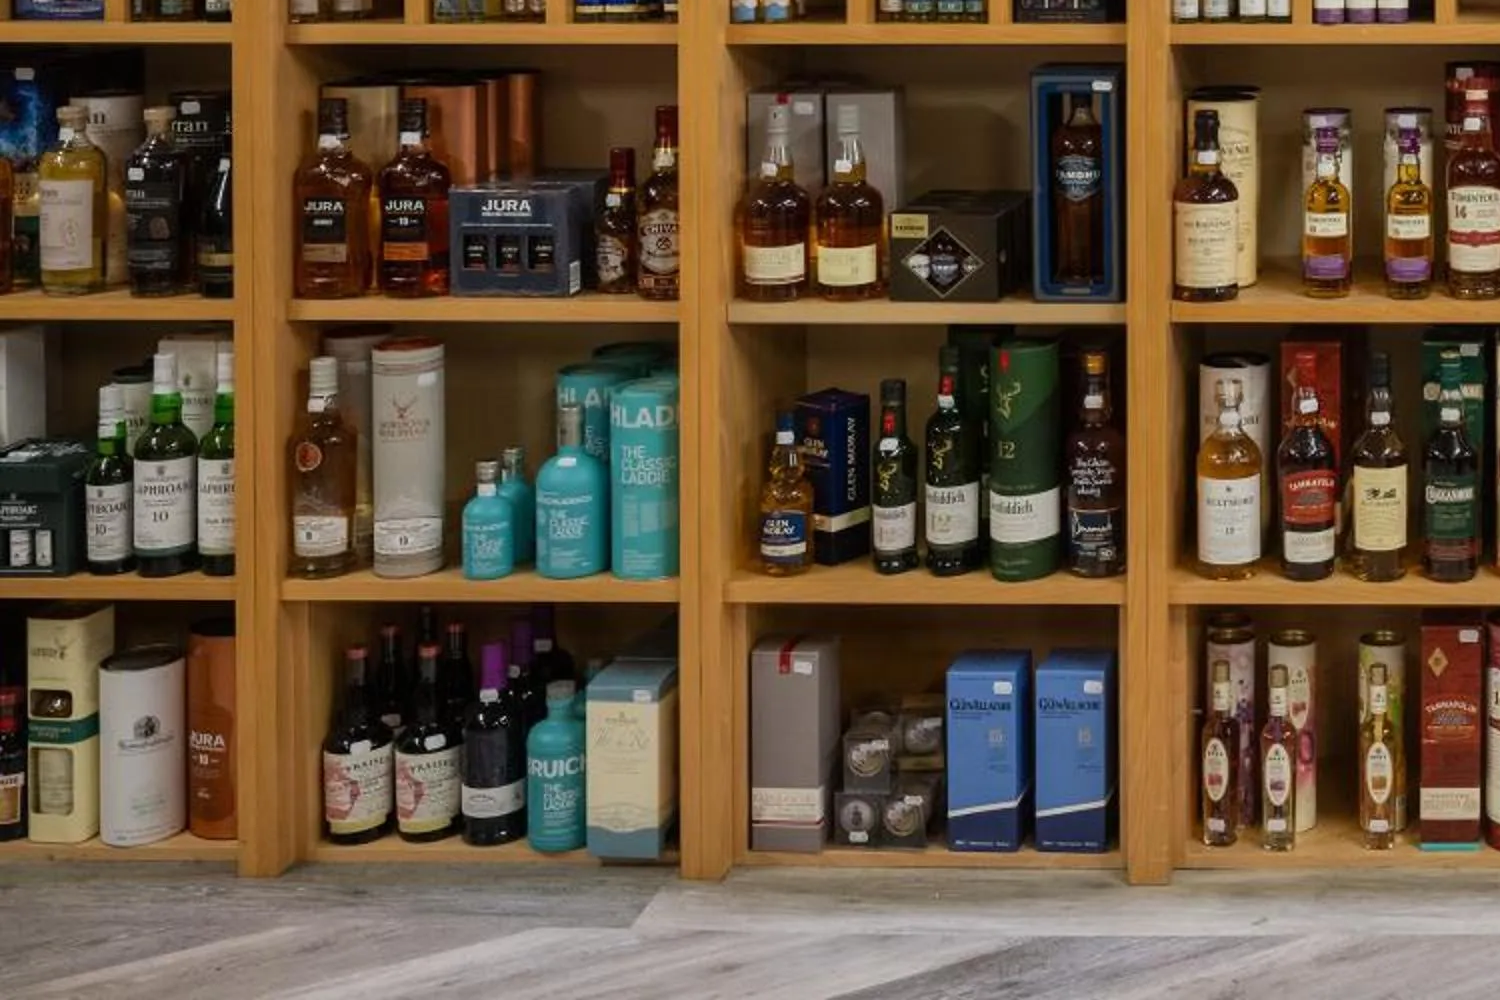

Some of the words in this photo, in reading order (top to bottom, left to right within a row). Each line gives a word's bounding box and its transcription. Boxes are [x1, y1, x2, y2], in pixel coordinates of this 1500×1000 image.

[304, 200, 344, 213] JURA
[385, 200, 424, 213] JURA
[481, 200, 532, 214] JURA
[847, 416, 857, 465] MORAY
[621, 446, 646, 458] THE
[998, 441, 1016, 459] 12
[621, 471, 669, 485] LADDIE
[847, 468, 857, 501] GLEN
[152, 511, 169, 523] 10
[766, 518, 790, 527] GLEN
[763, 525, 797, 537] MORAY
